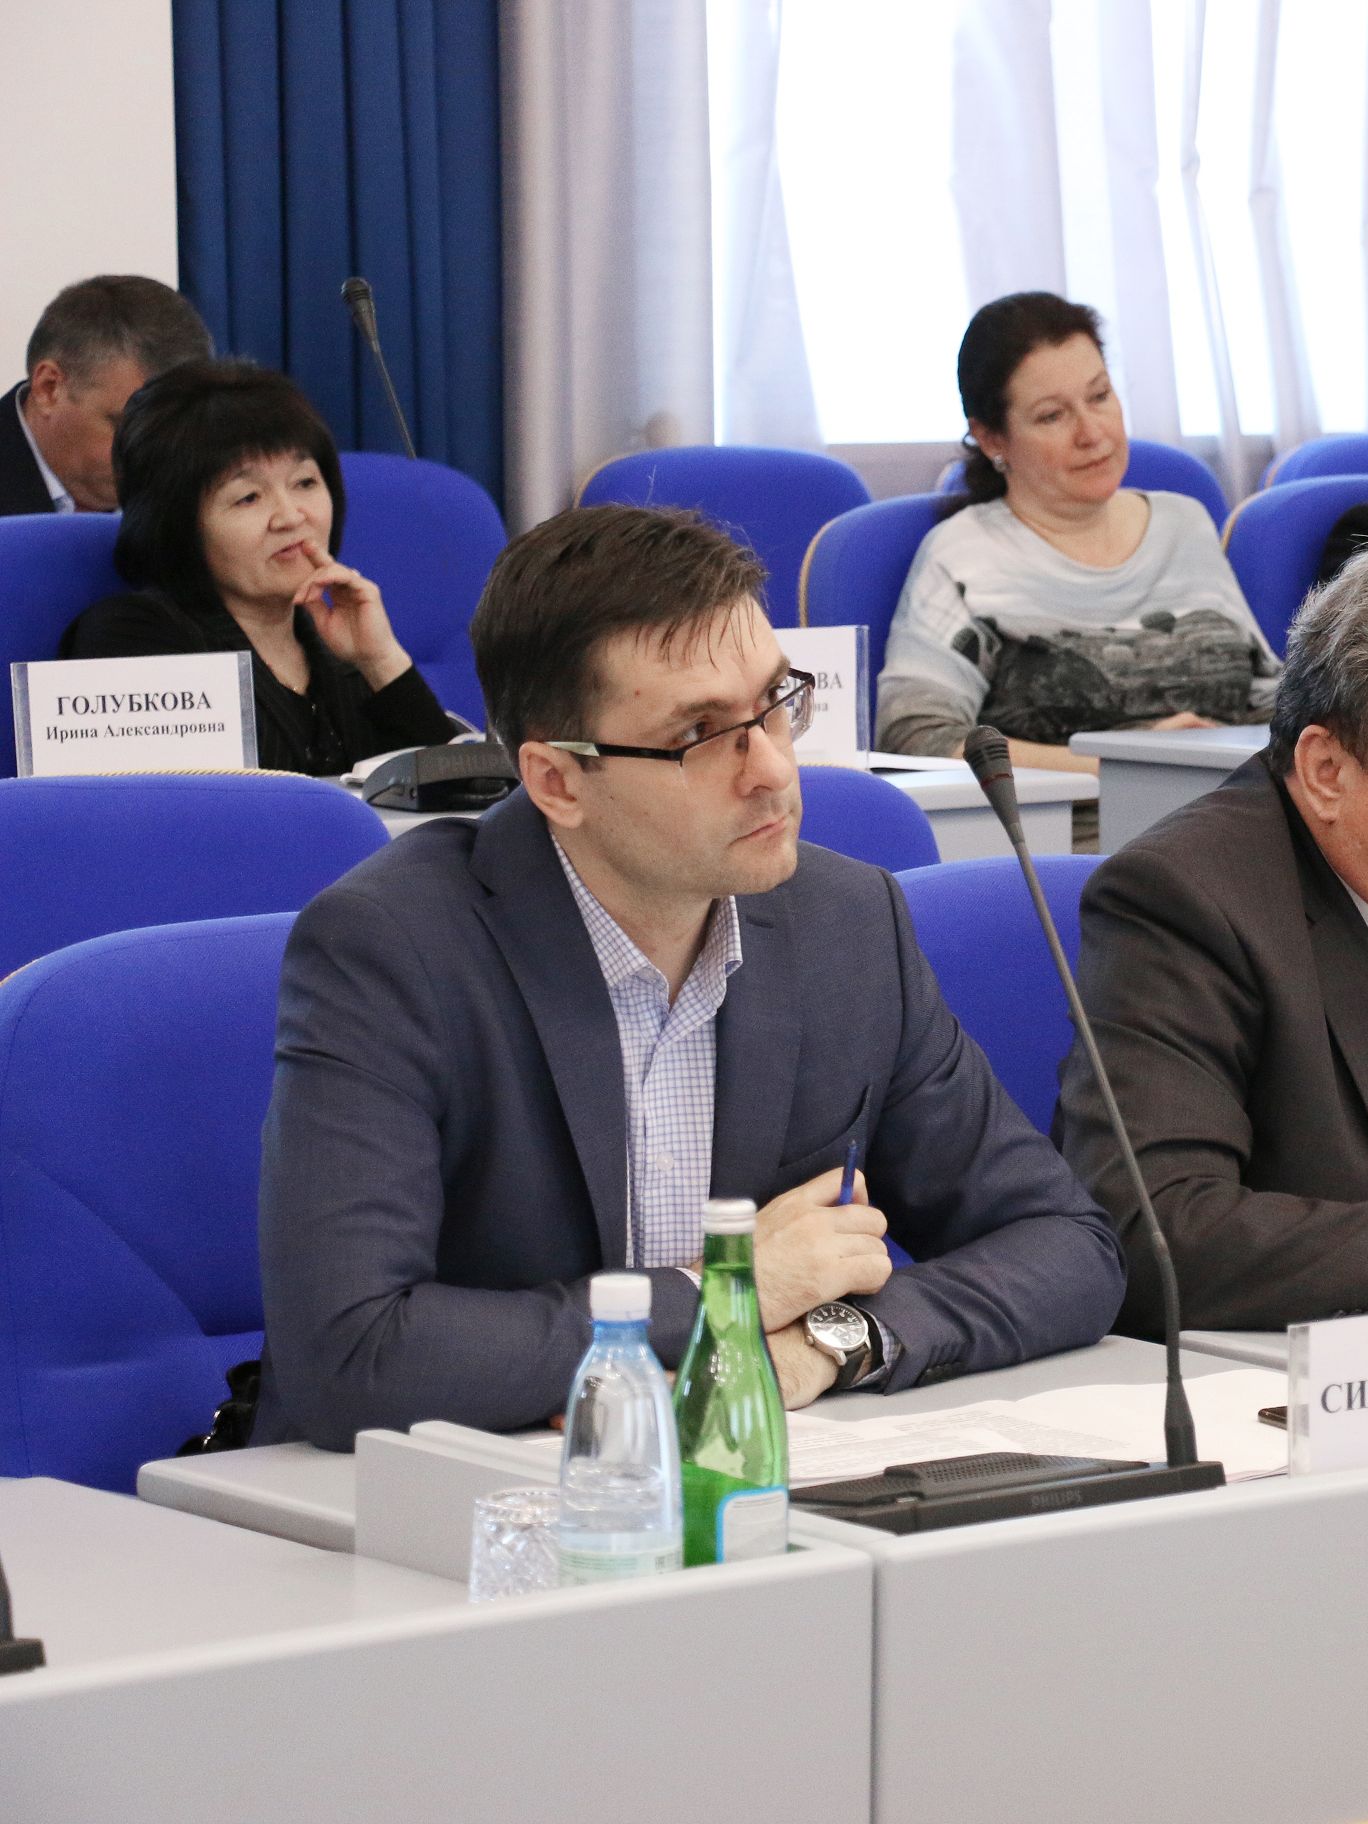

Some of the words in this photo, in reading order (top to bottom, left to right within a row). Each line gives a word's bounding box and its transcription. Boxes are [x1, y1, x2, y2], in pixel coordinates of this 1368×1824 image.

[57, 691, 212, 716] ГОЛУБКОВА
[46, 726, 98, 743] Ирина
[104, 721, 225, 738] Александровна
